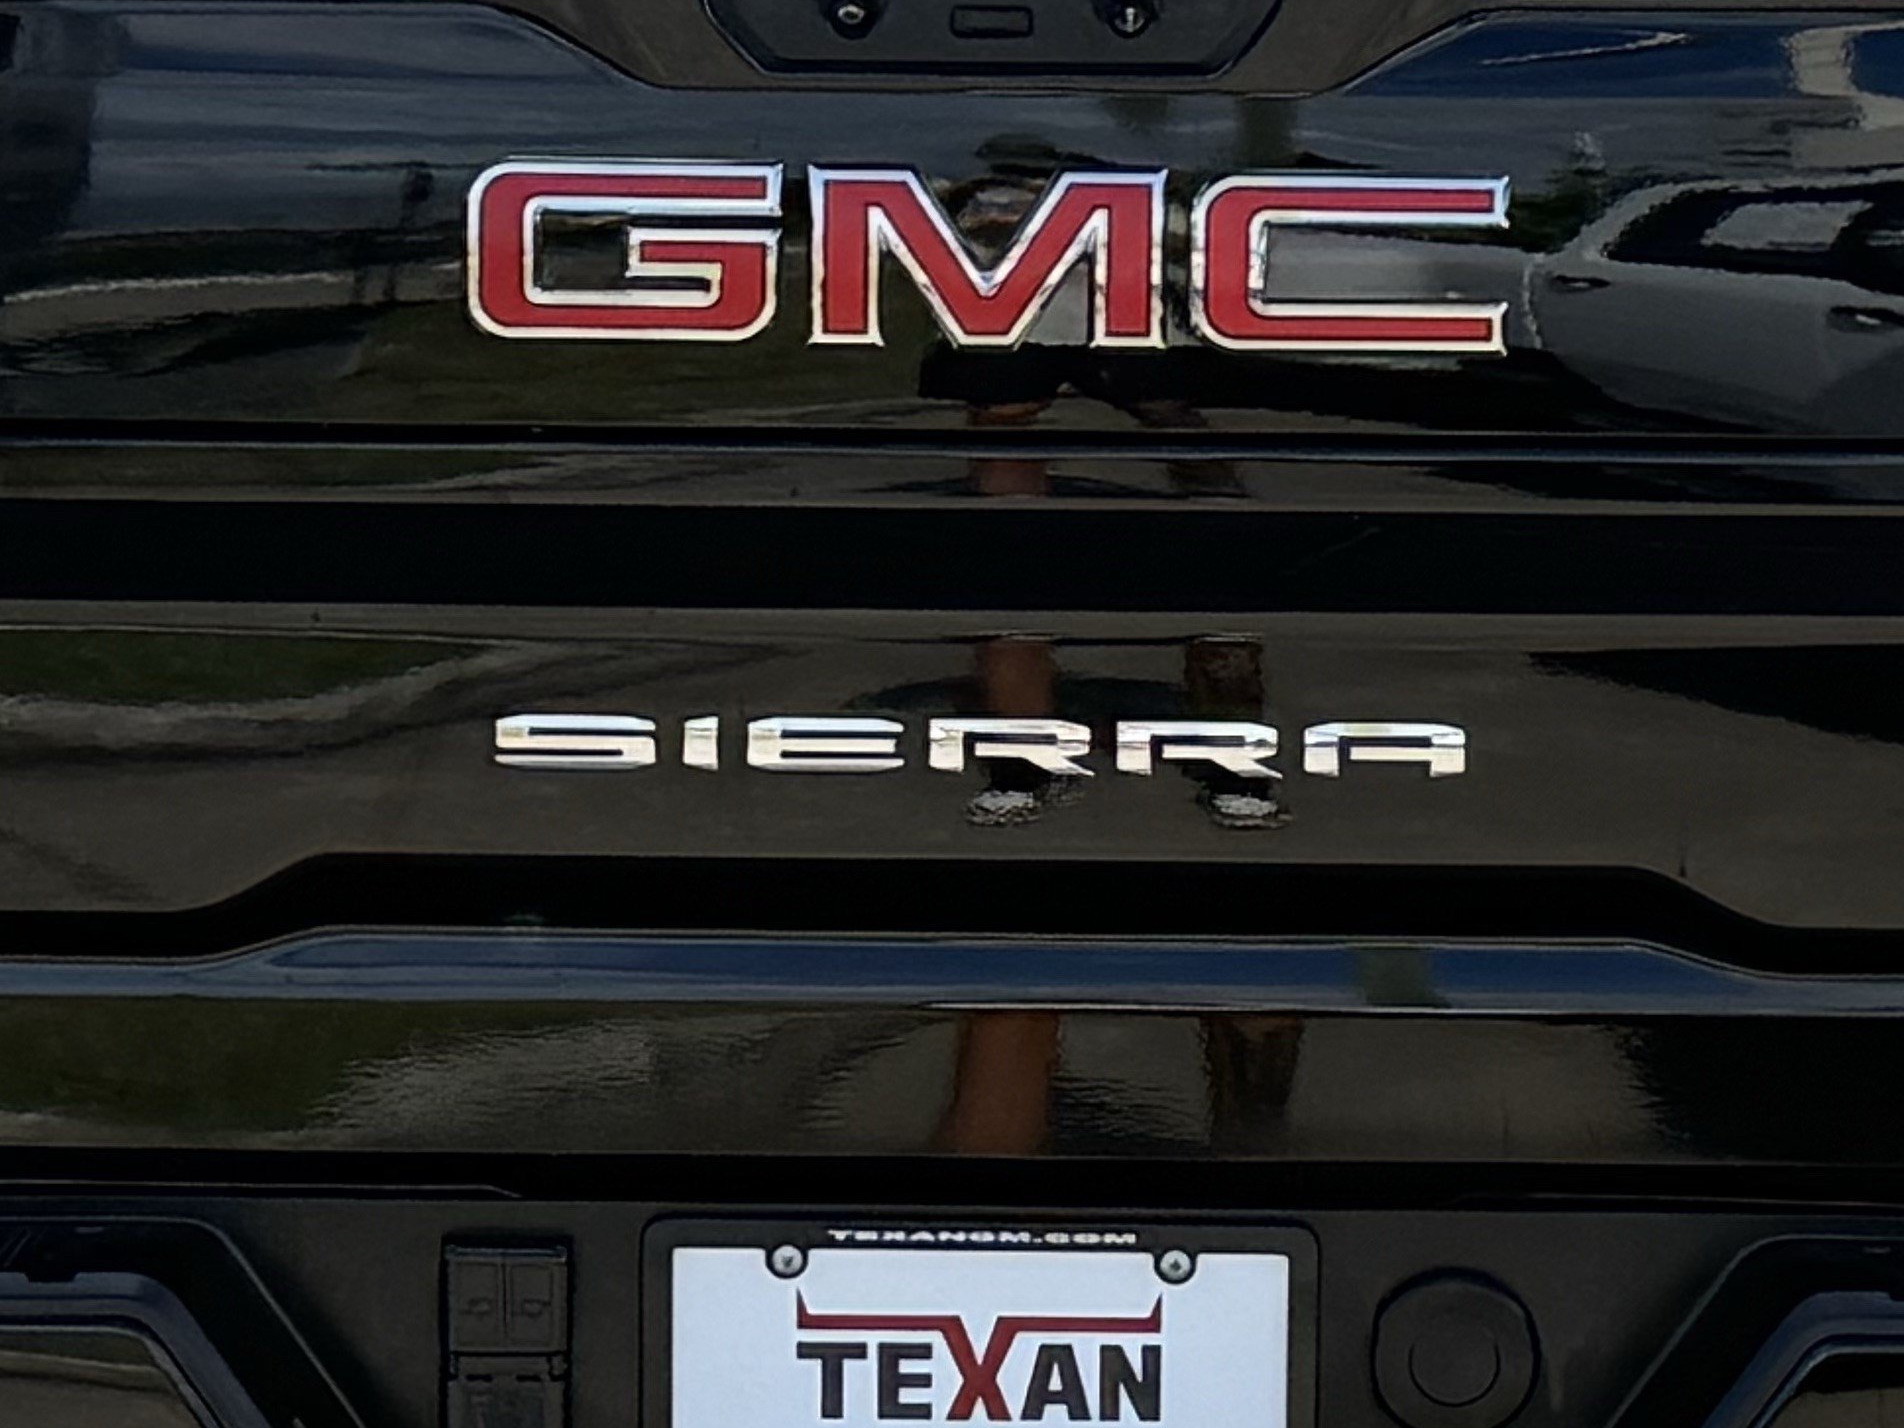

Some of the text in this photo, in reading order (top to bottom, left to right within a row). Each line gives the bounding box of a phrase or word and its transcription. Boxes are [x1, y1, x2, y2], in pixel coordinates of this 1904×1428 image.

[467, 156, 1509, 355] GMC
[495, 714, 1466, 779] SIERRA
[796, 1316, 1162, 1422] TEXAN
